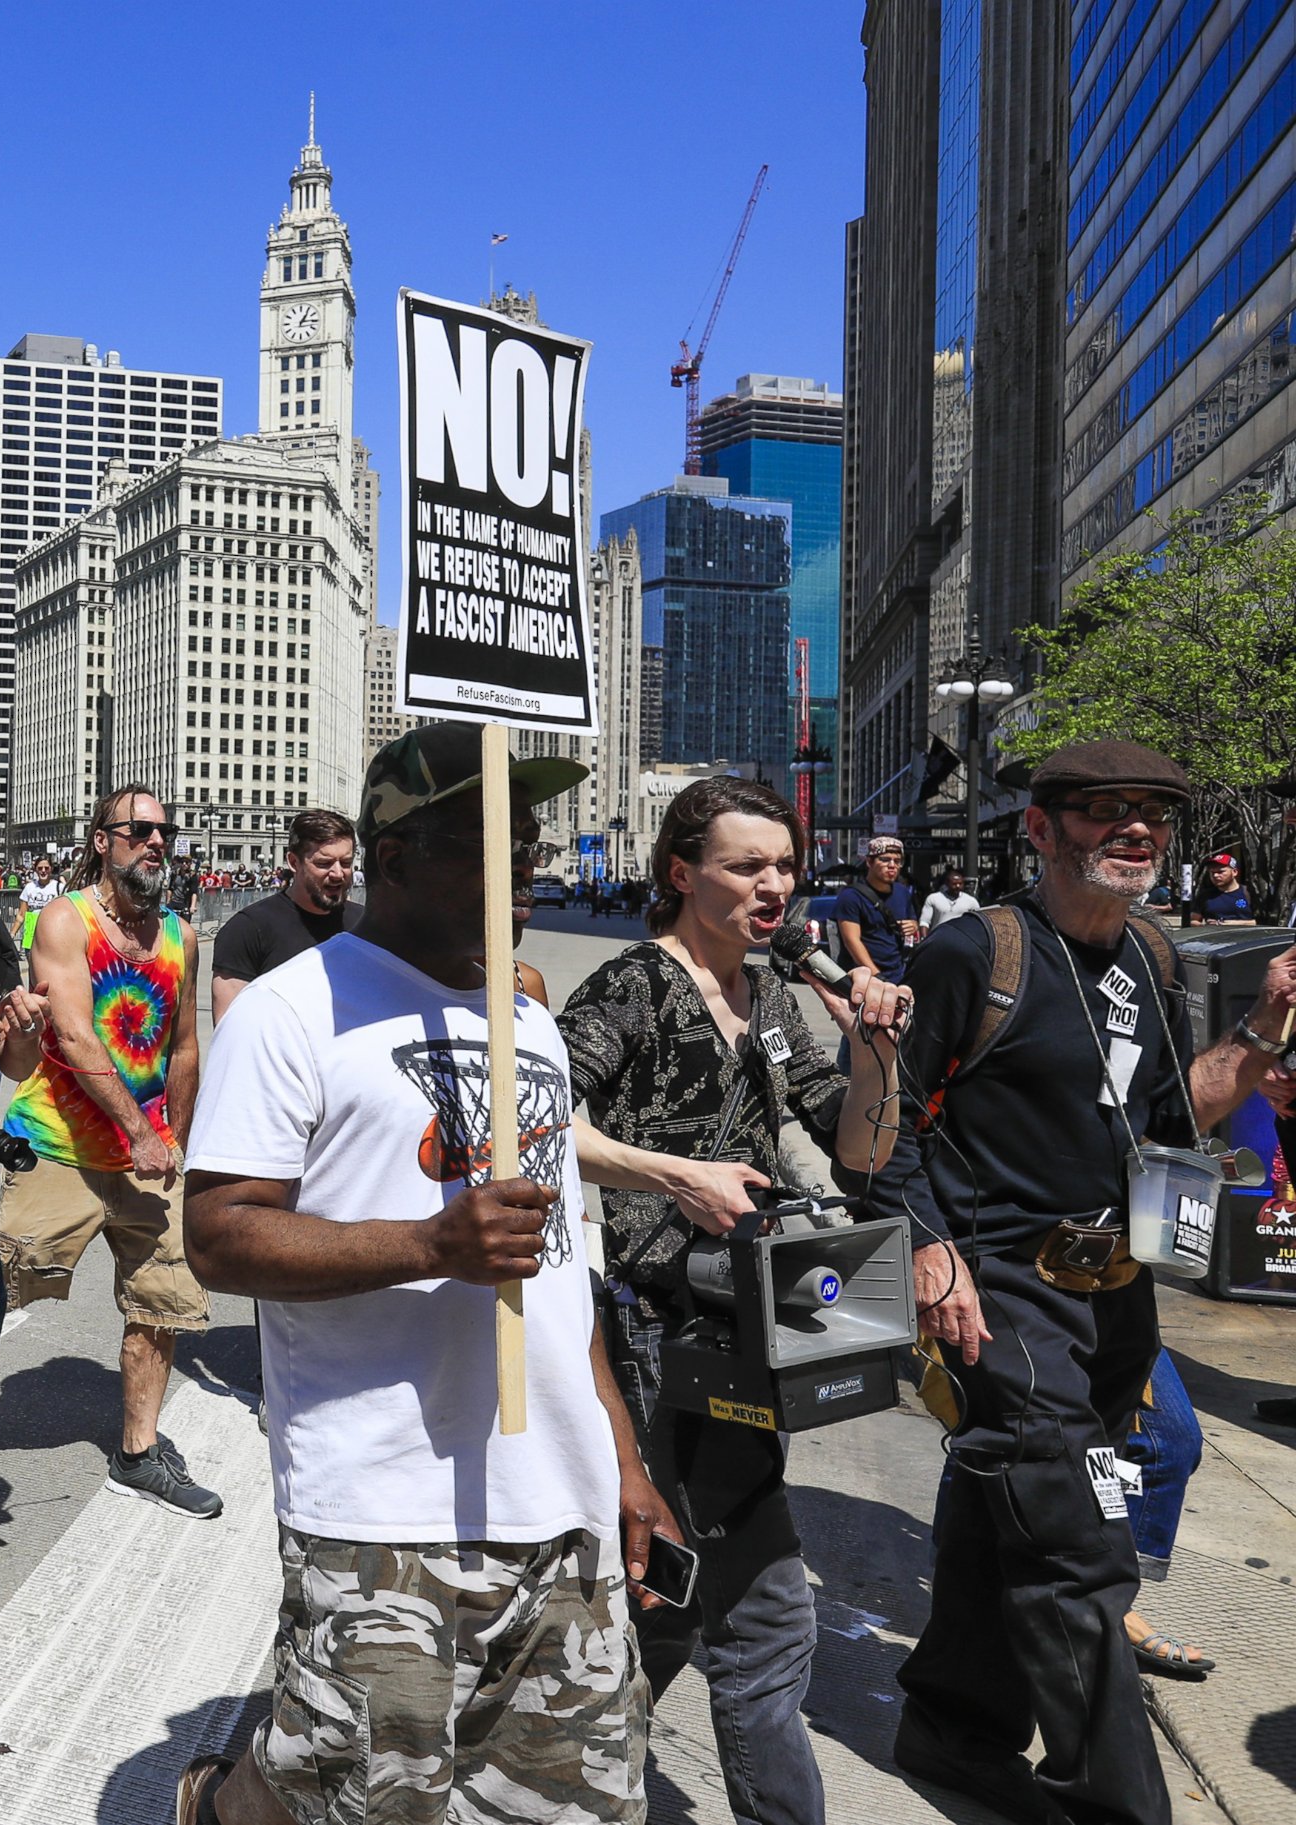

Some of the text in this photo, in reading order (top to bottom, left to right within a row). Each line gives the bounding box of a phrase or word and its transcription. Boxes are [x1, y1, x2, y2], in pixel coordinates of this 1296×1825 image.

[413, 313, 576, 517] NO!
[417, 500, 571, 566] IN THE NAME OF HUMANITY
[416, 540, 571, 608] WE REFUSE TO ACCEPT
[416, 586, 580, 659] A FASCIST AMERICA
[457, 685, 540, 712] RefuseFascism.org
[1104, 969, 1133, 1000] NO!
[1109, 1007, 1137, 1028] NO!
[763, 1031, 788, 1056] NO!
[515, 1073, 535, 1082] HE
[1179, 1196, 1215, 1234] NO!
[1256, 1226, 1296, 1237] GRAN
[712, 1403, 729, 1414] Was
[732, 1406, 769, 1425] NEVER
[1087, 1451, 1119, 1480] NO!
